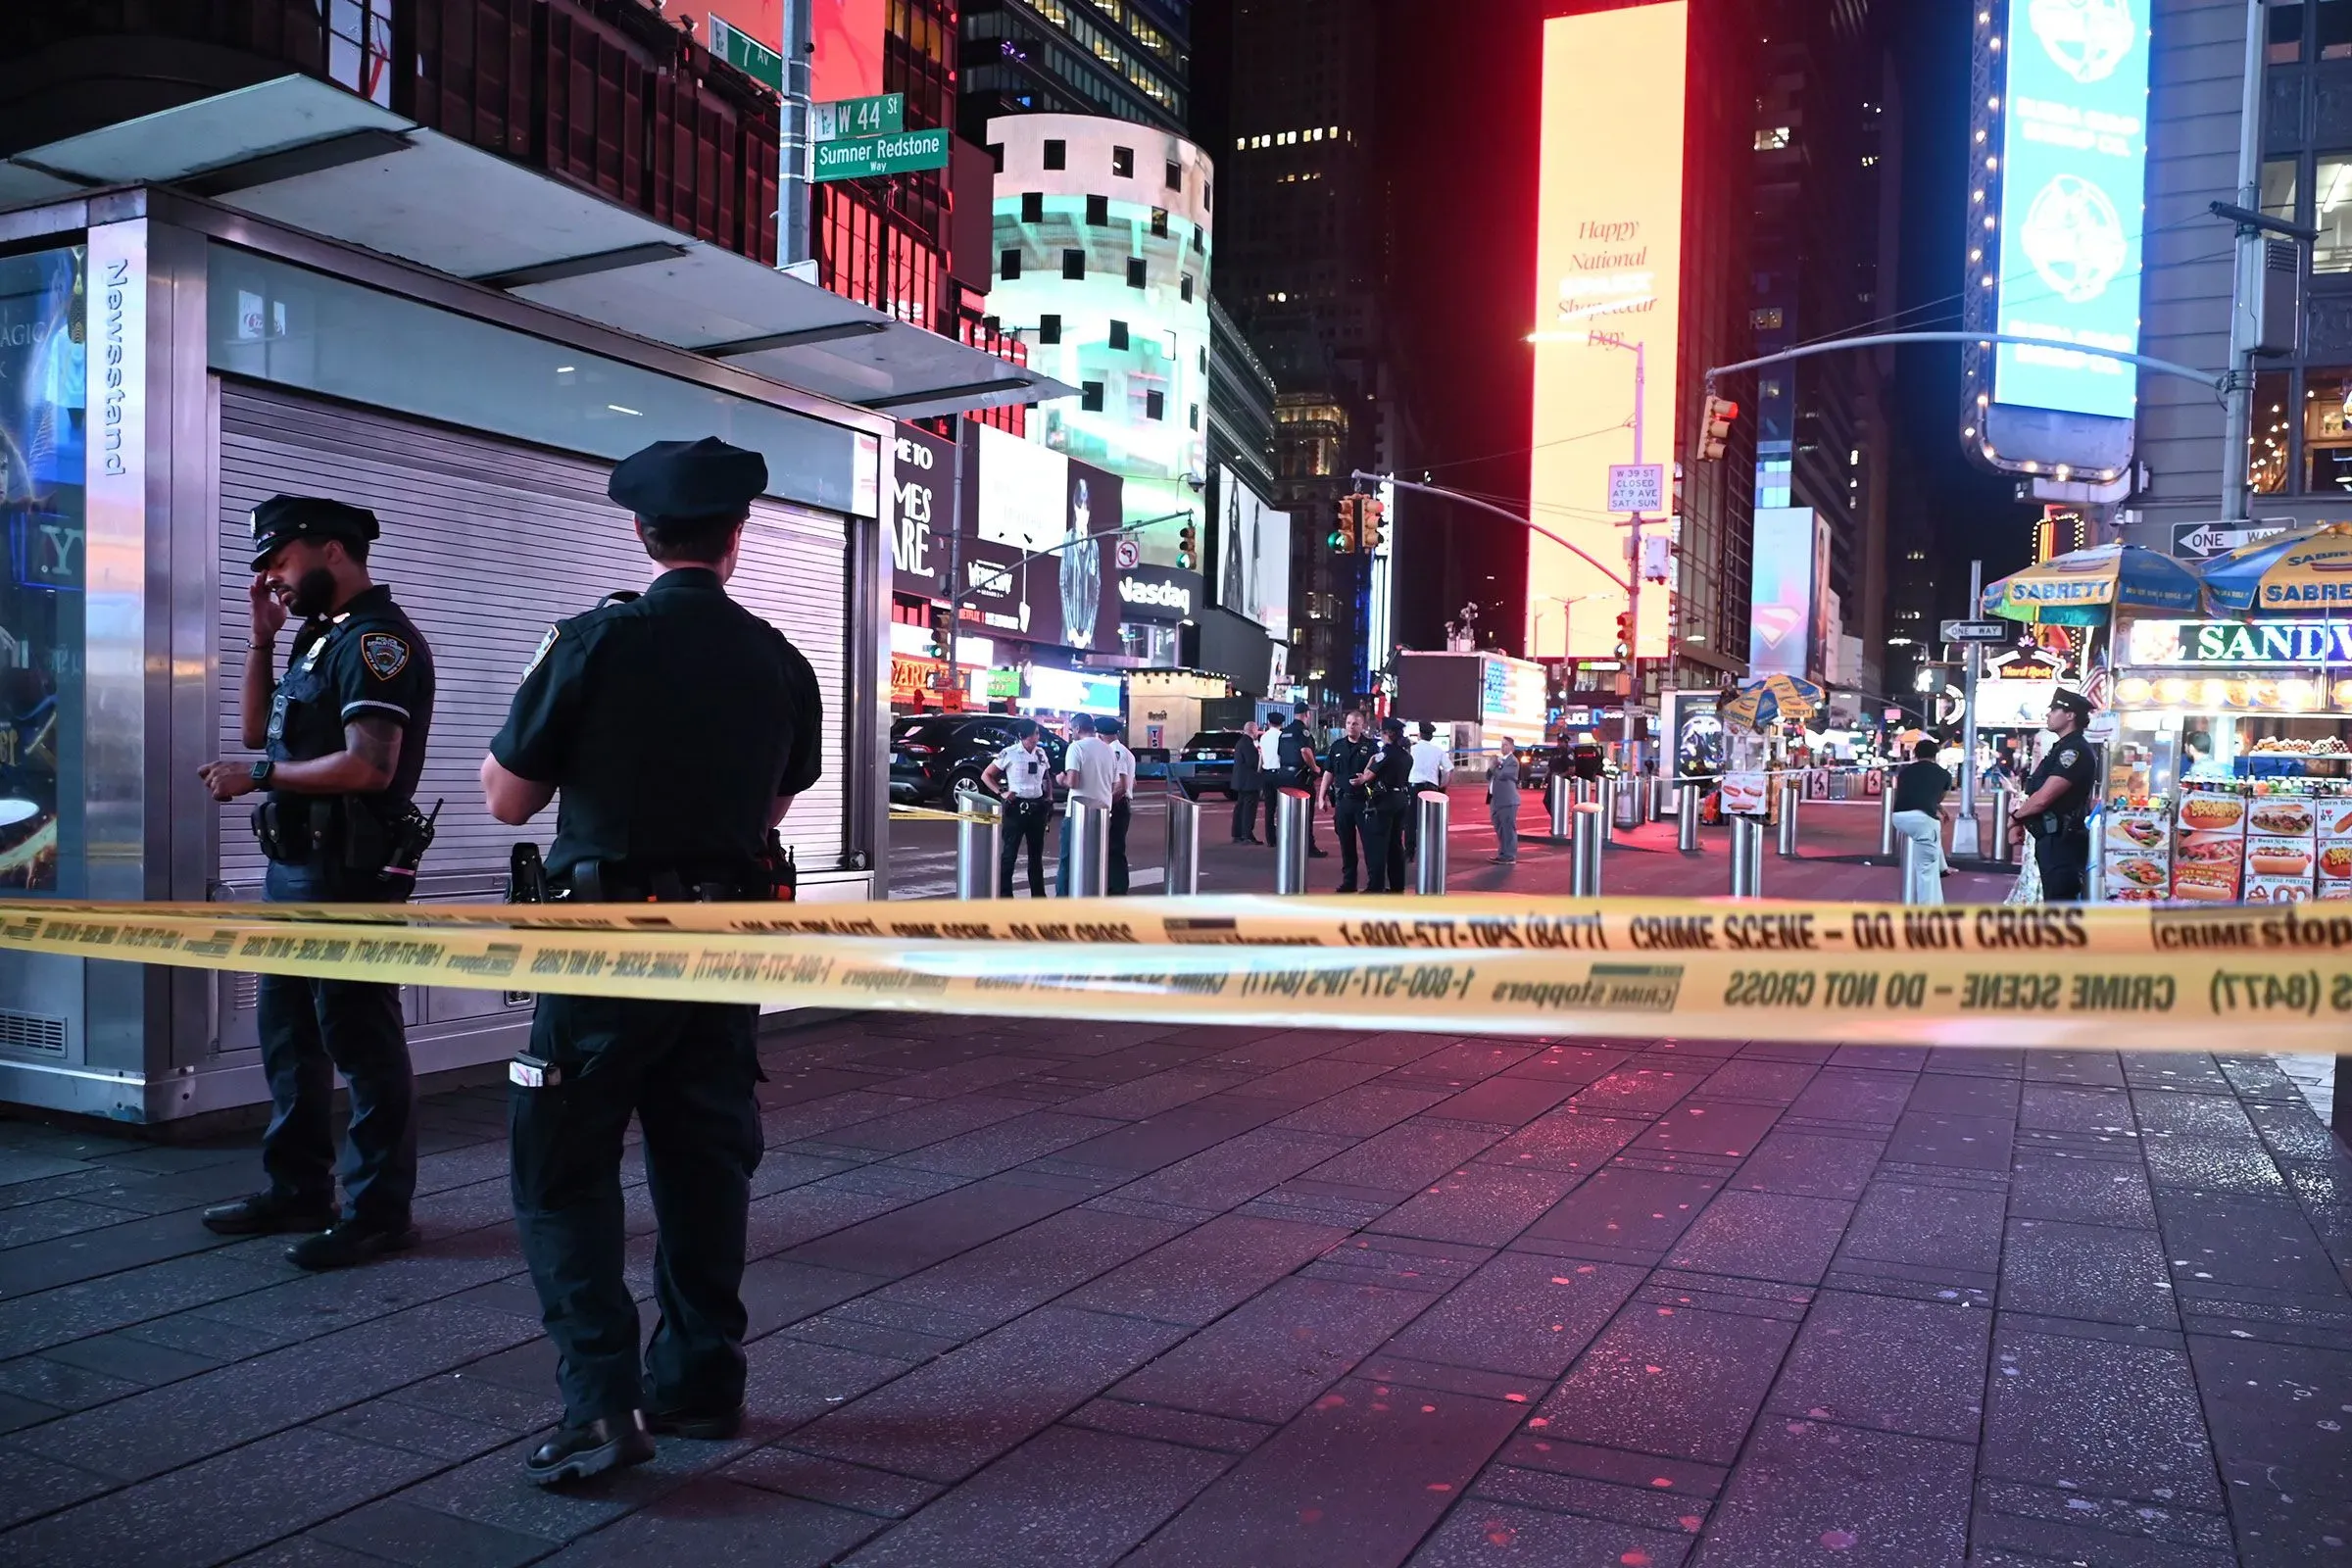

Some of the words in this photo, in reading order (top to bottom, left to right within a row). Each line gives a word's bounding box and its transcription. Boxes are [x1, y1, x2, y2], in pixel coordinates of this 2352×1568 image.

[741, 37, 752, 68] 7
[757, 49, 769, 66] Av
[838, 105, 852, 133] W
[858, 102, 880, 130] 44
[888, 97, 898, 115] St
[819, 141, 871, 166] Sumner
[877, 136, 940, 160] Redstone
[870, 161, 887, 172] Way
[1579, 220, 1641, 243] Happy
[1569, 246, 1647, 271] National
[105, 258, 128, 477] Newsstand
[912, 444, 933, 470] TO
[1616, 479, 1655, 488] CLOSED
[1628, 469, 1641, 478] 39
[1642, 469, 1655, 478] ST
[1628, 489, 1635, 498] 9
[2192, 533, 2224, 548] ONE
[1118, 576, 1191, 615] Nasdaq
[2012, 581, 2110, 601] SABRETT
[1951, 625, 1970, 636] ONE
[1979, 625, 1999, 636] WAY
[2002, 665, 2028, 678] Hard
[2029, 665, 2052, 678] Rock
[1629, 914, 1720, 951] CRIME
[1723, 912, 1820, 951] SCENE
[1851, 910, 1896, 950] DO
[1903, 910, 1966, 950] NOT
[1975, 907, 2089, 949] CROSS
